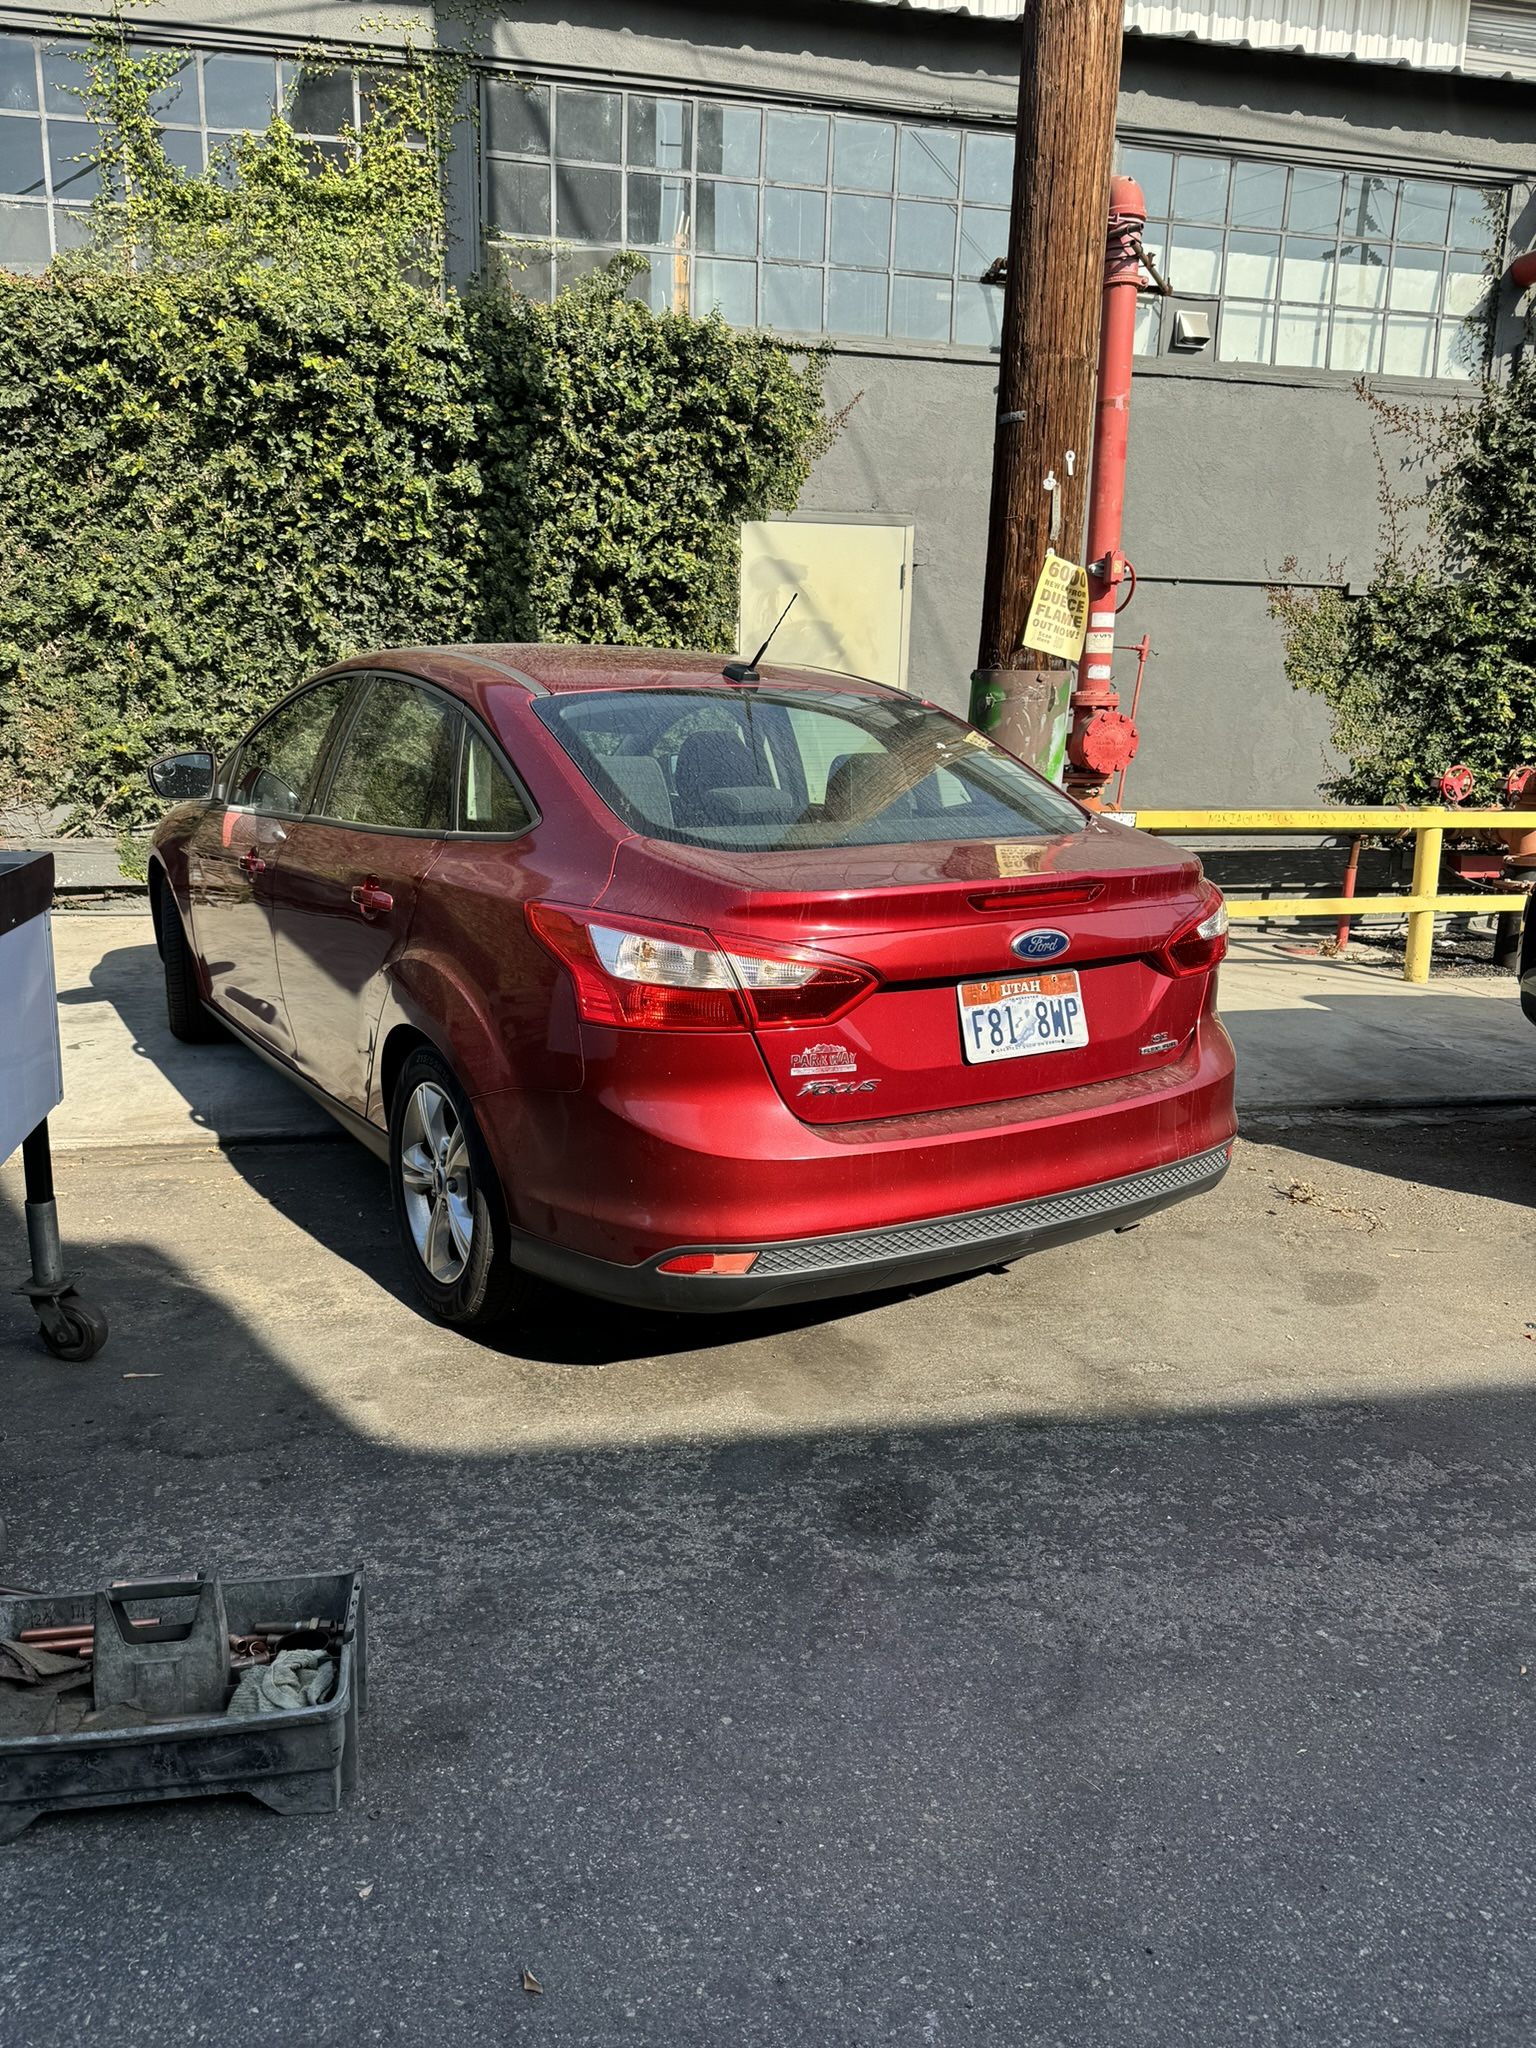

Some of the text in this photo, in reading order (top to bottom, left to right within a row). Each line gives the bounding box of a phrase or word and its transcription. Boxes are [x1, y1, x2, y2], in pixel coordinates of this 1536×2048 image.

[1045, 579, 1060, 590] NEW
[1040, 588, 1085, 614] DUECE
[1035, 604, 1083, 628] FLAME
[1032, 618, 1080, 640] OUT NOW!
[1028, 935, 1059, 953] Ford
[1000, 980, 1041, 997] UTAH
